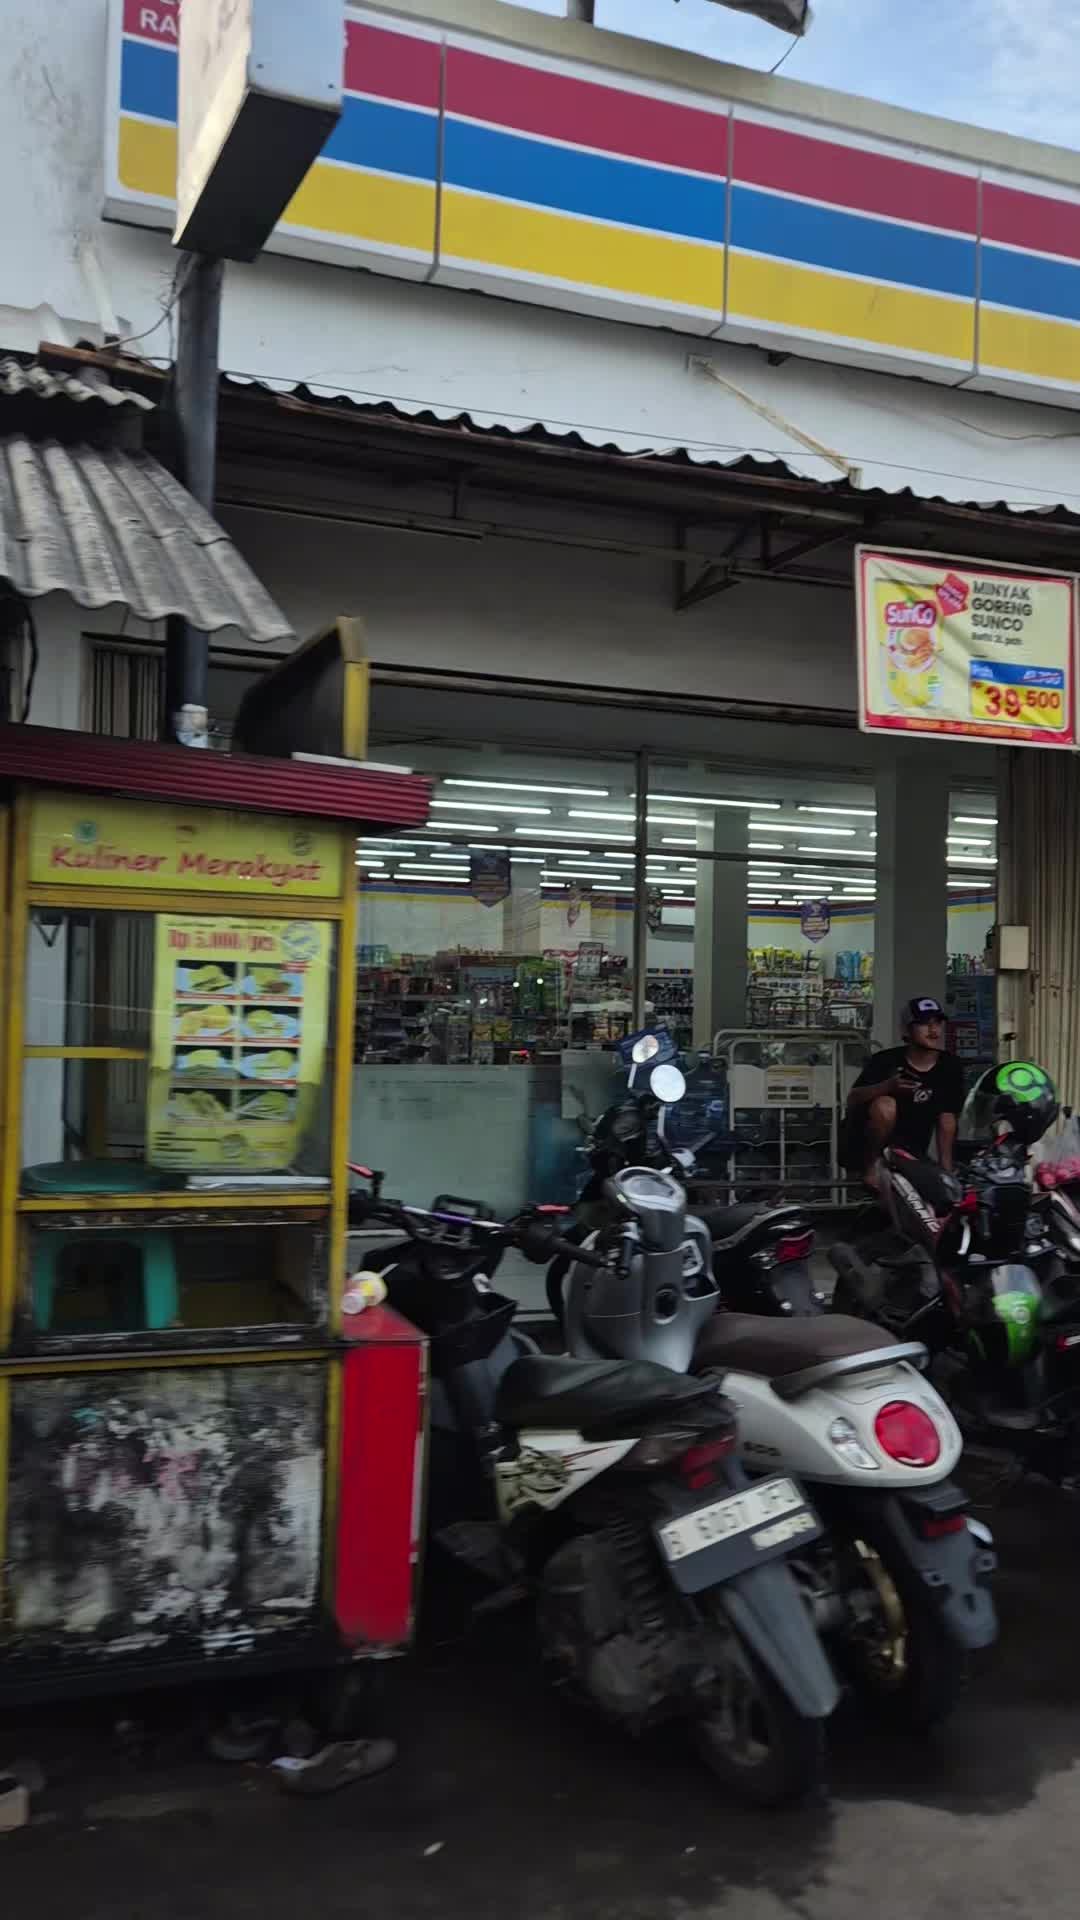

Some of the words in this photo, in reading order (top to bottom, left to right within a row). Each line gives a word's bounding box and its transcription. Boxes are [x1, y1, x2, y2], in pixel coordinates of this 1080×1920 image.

[973, 581, 1030, 600] MINYAK
[972, 598, 1032, 616] GORENG
[972, 614, 1023, 631] SUNCO
[51, 846, 167, 873] Kuliner
[177, 851, 323, 886] Merakyat
